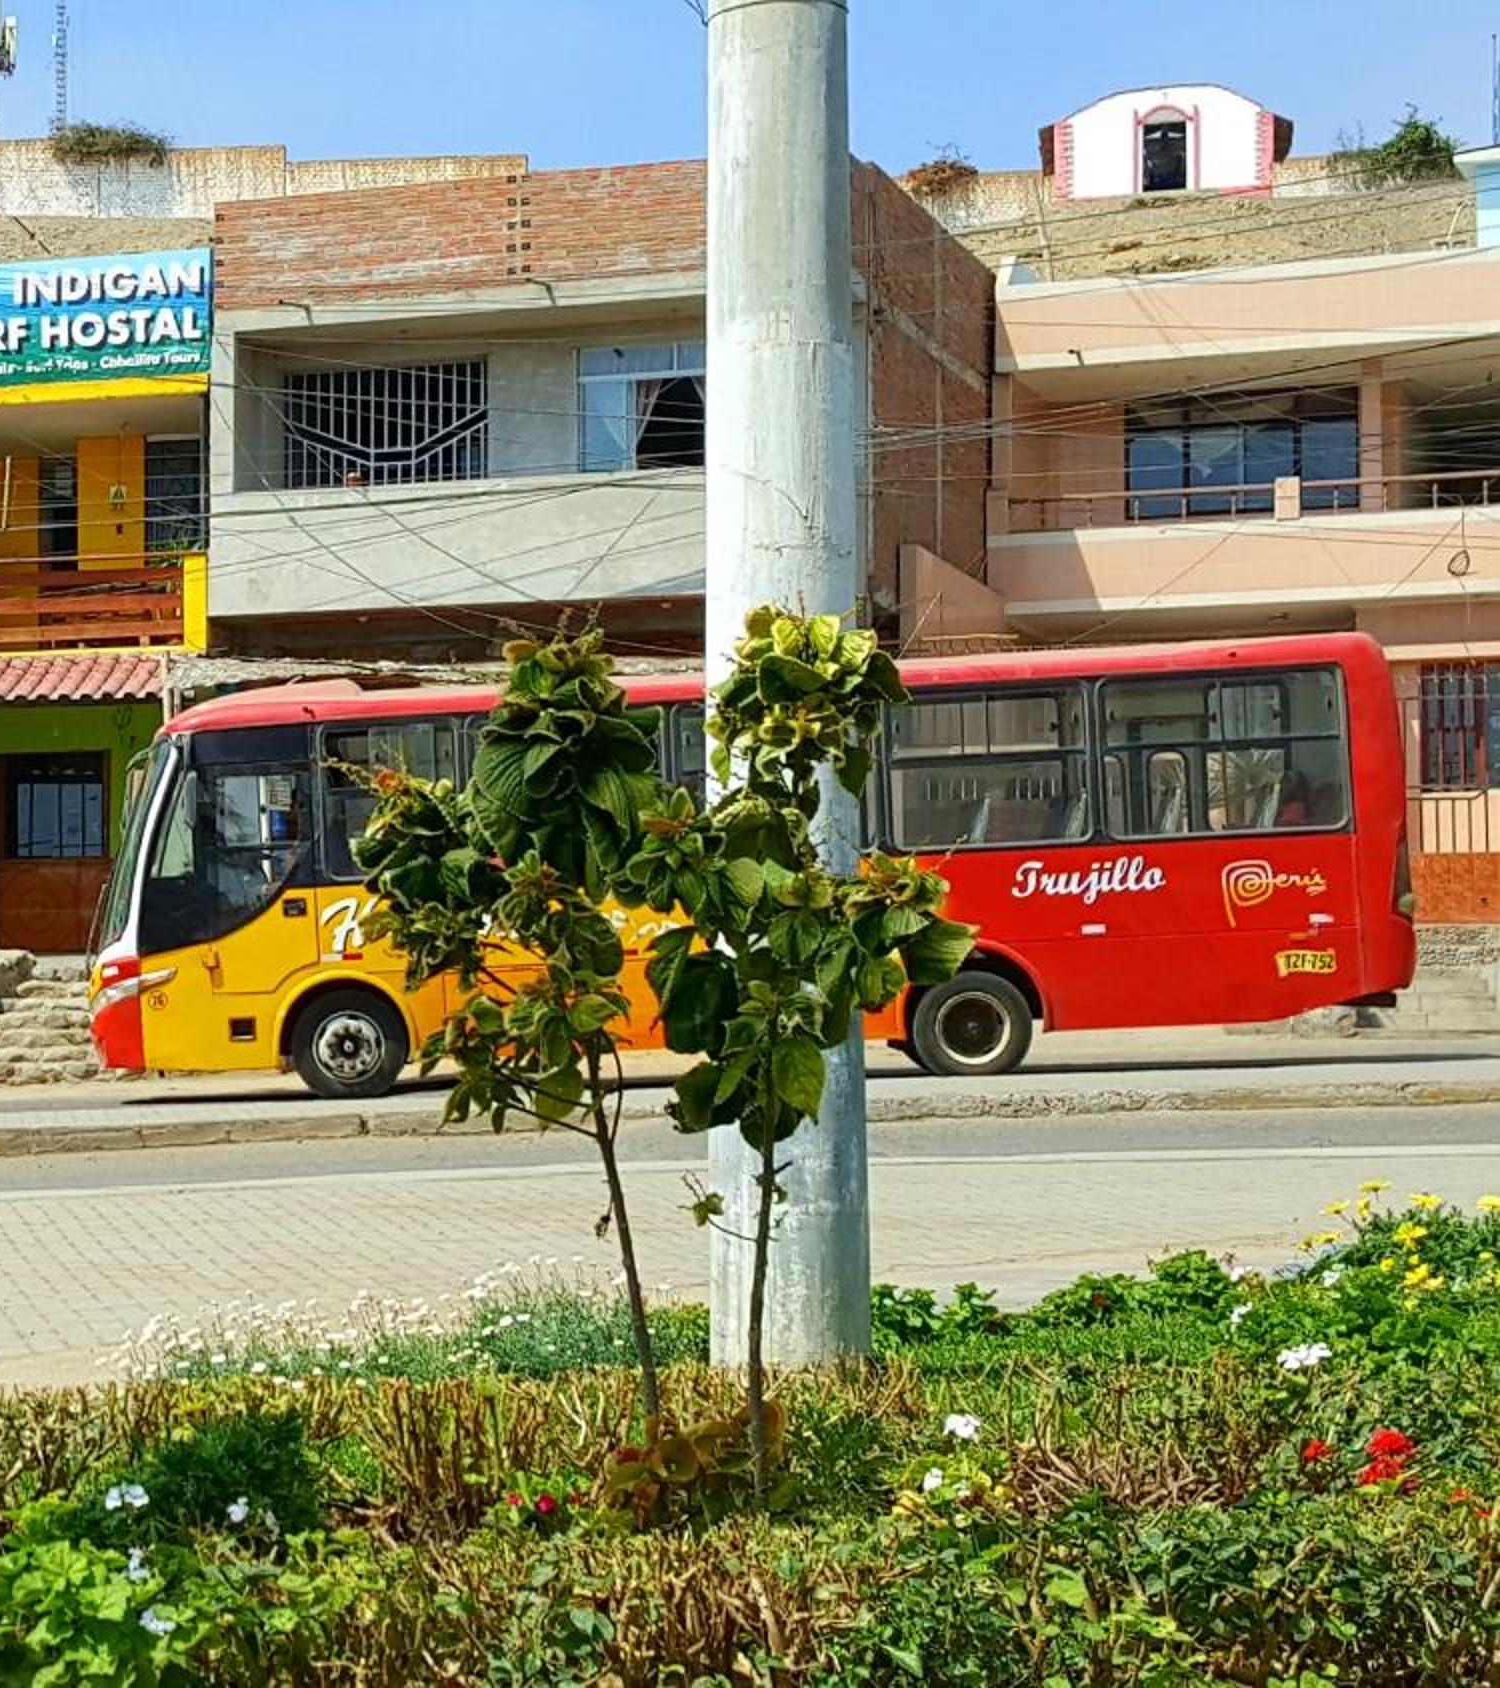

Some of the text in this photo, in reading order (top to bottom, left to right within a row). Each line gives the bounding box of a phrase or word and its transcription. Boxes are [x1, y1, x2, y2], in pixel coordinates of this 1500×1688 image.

[13, 260, 204, 308] INDIGAN
[40, 307, 202, 349] HOSTAL
[164, 351, 201, 365] Tours
[1011, 855, 1166, 905] Trujillo
